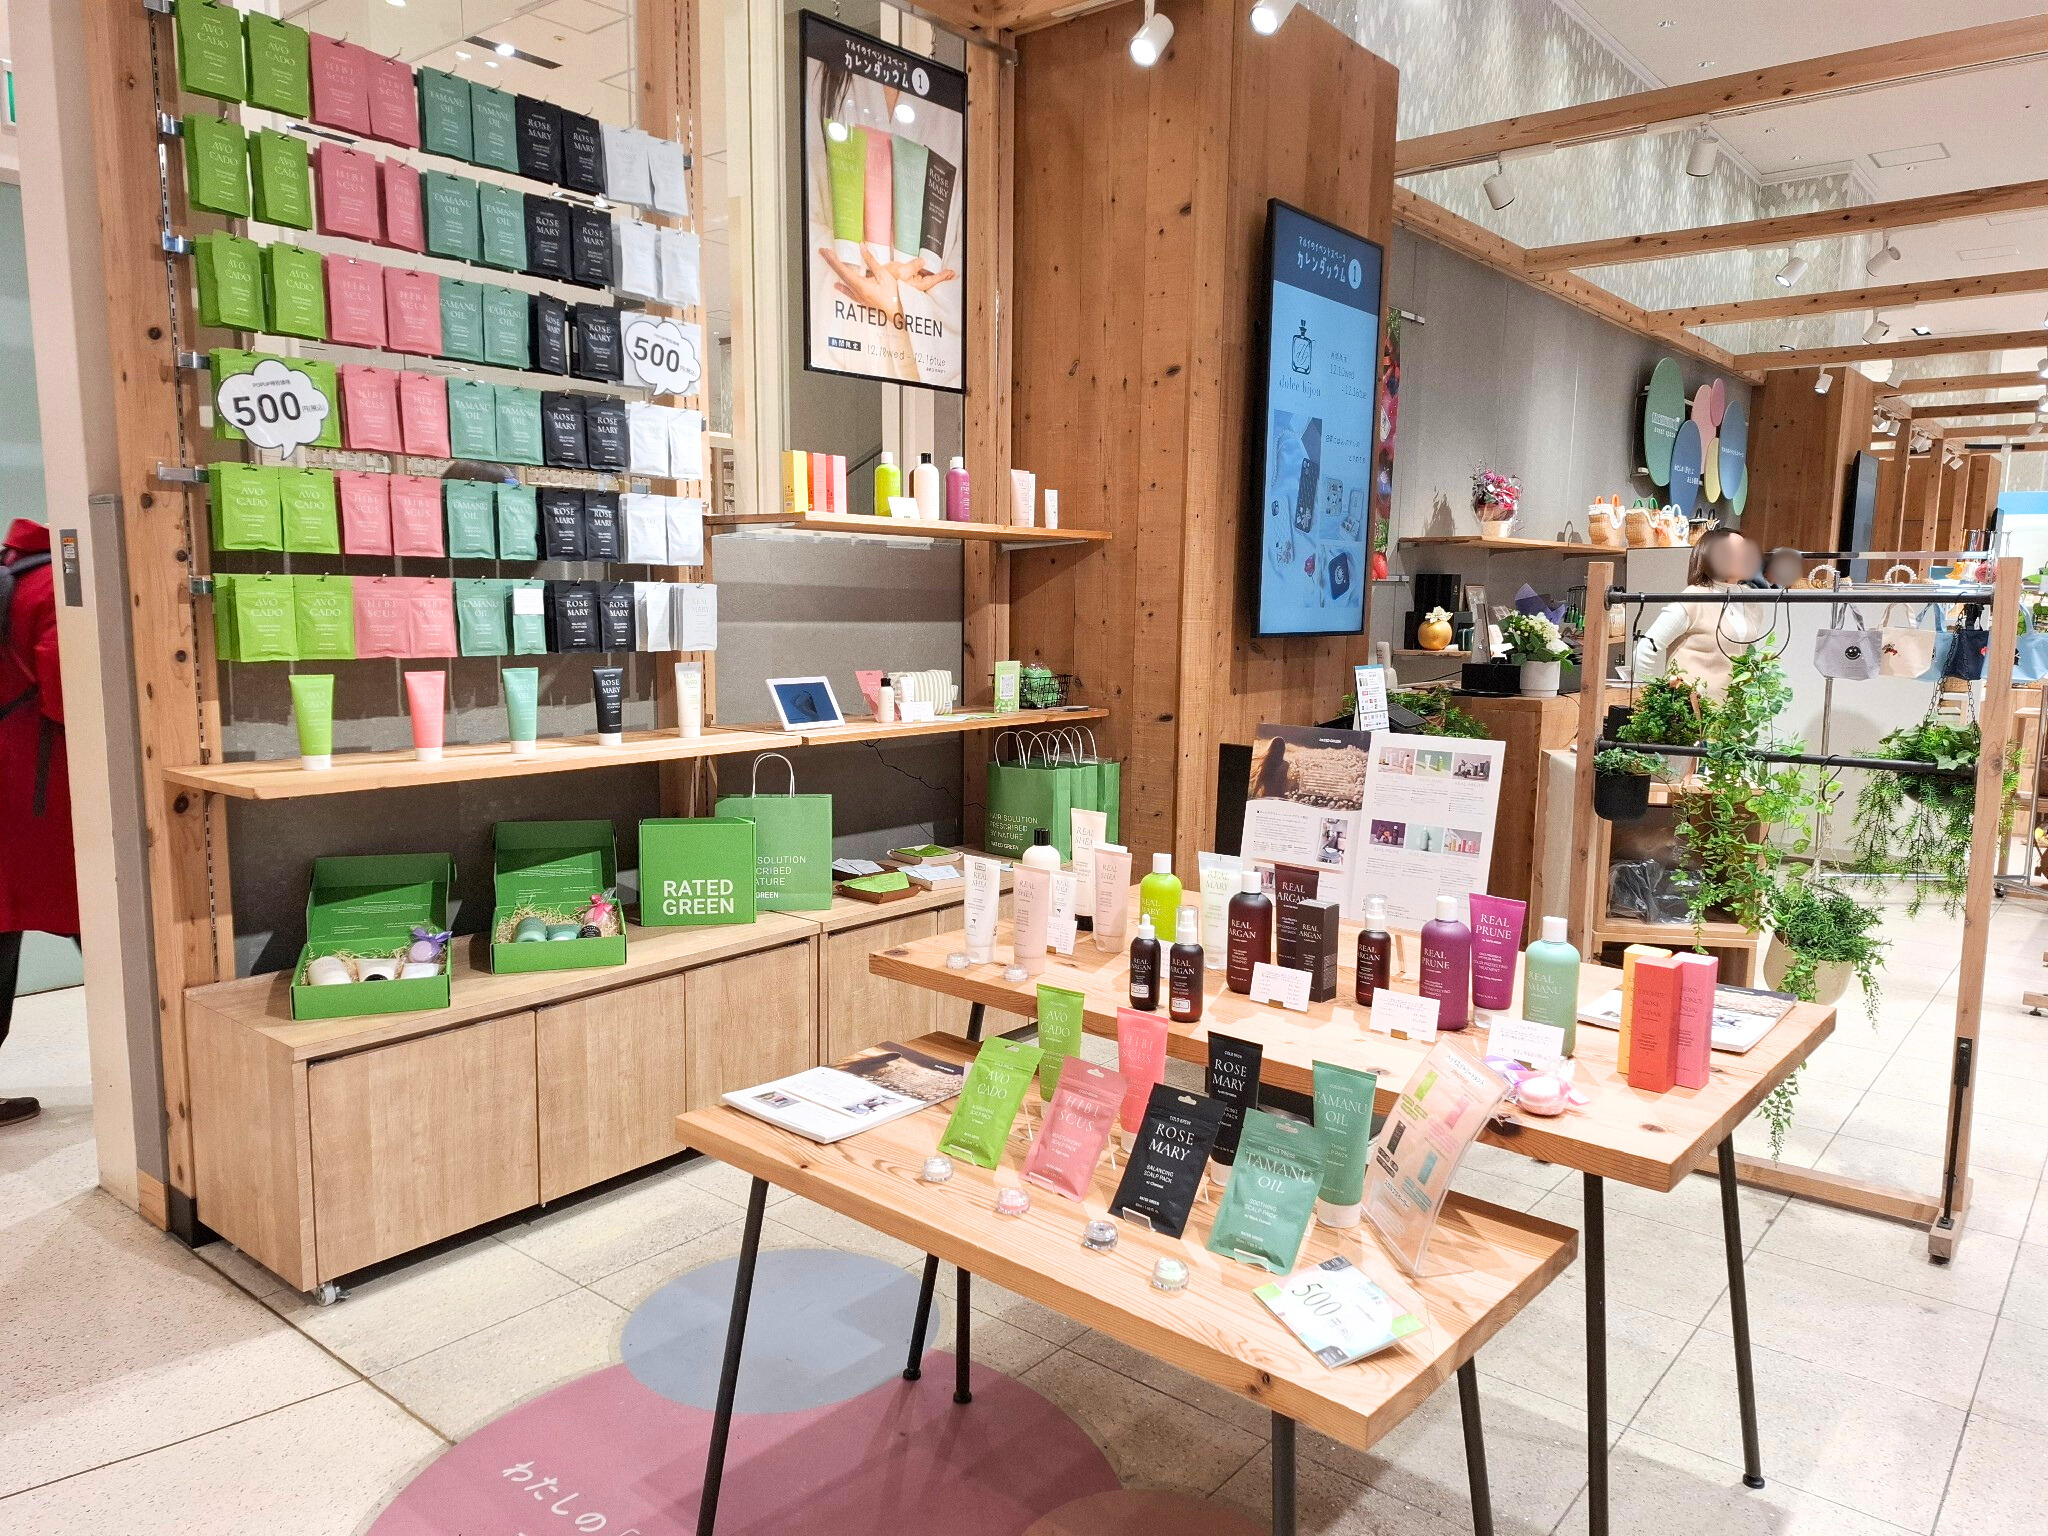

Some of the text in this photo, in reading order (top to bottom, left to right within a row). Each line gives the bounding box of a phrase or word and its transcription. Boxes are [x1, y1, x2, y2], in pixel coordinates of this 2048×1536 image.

[266, 50, 296, 66] CADO
[844, 53, 908, 88] カレンダリウム
[528, 118, 552, 132] ROSE
[528, 128, 552, 140] MARY
[573, 132, 594, 144] ROSE
[574, 141, 594, 153] MARY
[930, 168, 949, 188] ROSE
[928, 180, 949, 198] MARY
[536, 216, 560, 228] ROSE
[536, 226, 560, 237] MARY
[582, 226, 604, 238] ROSE
[583, 236, 604, 246] MARY
[228, 260, 246, 270] AVO
[225, 269, 250, 282] CADO
[289, 269, 308, 280] AVO
[286, 278, 314, 292] CADO
[545, 316, 560, 327] ROSE
[835, 300, 942, 338] RATED GREEN
[546, 324, 560, 336] MARY
[589, 324, 612, 334] ROSE
[589, 333, 612, 342] MARY
[633, 335, 680, 373] 500
[232, 390, 301, 427] 500
[553, 412, 575, 422] ROSE
[597, 416, 618, 426] ROSE
[554, 421, 576, 431] MARY
[597, 425, 619, 434] MARY
[240, 487, 264, 496] AVO
[298, 490, 320, 499] AVO
[236, 497, 268, 507] CADO
[354, 494, 378, 504] HIBI
[404, 499, 430, 507] HIBI
[294, 500, 324, 510] CADO
[354, 505, 380, 514] SCUS
[454, 500, 488, 512] TAMANU
[404, 508, 430, 517] SCUS
[463, 511, 478, 520] OIL
[553, 507, 576, 516] ROSE
[594, 509, 613, 518] ROSE
[554, 516, 576, 525] MARY
[594, 518, 613, 527] MARY
[255, 598, 278, 607] AVO
[313, 598, 336, 606] AVO
[366, 600, 397, 609] HIBI
[418, 600, 443, 608] HIBI
[566, 599, 588, 608] ROSE
[610, 600, 629, 609] ROSE
[250, 608, 283, 617] CADO
[309, 608, 342, 617] CADO
[366, 610, 397, 618] SCUS
[418, 610, 443, 618] SCUS
[567, 608, 589, 617] MARY
[610, 609, 629, 617] MARY
[601, 679, 620, 687] ROSE
[602, 686, 621, 694] MARY
[1004, 814, 1038, 824] SOLUTION
[998, 831, 1023, 840] NATURE
[1077, 826, 1094, 836] REAL
[757, 856, 806, 864] SOLUTION
[756, 866, 792, 874] CRIBED
[1102, 864, 1118, 872] REAL
[1100, 872, 1116, 880] SHEA
[1208, 870, 1229, 881] REAL
[663, 880, 733, 897] RATED
[1019, 880, 1034, 890] REAL
[1056, 879, 1069, 887] REAL
[1205, 880, 1229, 891] MARY
[1282, 882, 1306, 894] REAL
[1018, 890, 1034, 899] SHEA
[662, 898, 734, 916] GREEN
[1232, 918, 1252, 930] REAL
[1480, 913, 1510, 928] REAL
[1229, 928, 1256, 939] ARGAN
[1302, 924, 1318, 932] REAL
[1476, 924, 1512, 940] PRUNE
[1298, 930, 1322, 940] ARGAN
[1358, 943, 1377, 953] REAL
[1424, 948, 1446, 960] REAL
[1172, 958, 1190, 966] REAL
[1422, 957, 1450, 970] PRUNE
[1046, 1010, 1068, 1022] AVO
[1040, 1022, 1070, 1037] CADO
[1123, 1034, 1153, 1050] HIBI
[1122, 1048, 1151, 1064] SCUS
[1214, 1058, 1247, 1078] ROSE
[986, 1070, 1010, 1084] AVO
[1212, 1072, 1246, 1092] MARY
[978, 1083, 1007, 1099] CADO
[1065, 1095, 1099, 1117] HIBI
[1314, 1090, 1368, 1115] TAMANU
[1058, 1109, 1095, 1132] SCUS
[1325, 1110, 1348, 1126] OIL
[1155, 1122, 1195, 1146] ROSE
[1148, 1138, 1190, 1161] MARY
[1146, 1164, 1174, 1177] BALANCING
[1246, 1150, 1314, 1183] TAMANU
[1144, 1170, 1173, 1184] SCALP PACK
[1258, 1175, 1284, 1194] OIL
[1249, 1198, 1277, 1212] SOOTHING
[1244, 1204, 1278, 1220] SCALP PACK
[1292, 1283, 1342, 1316] 500
